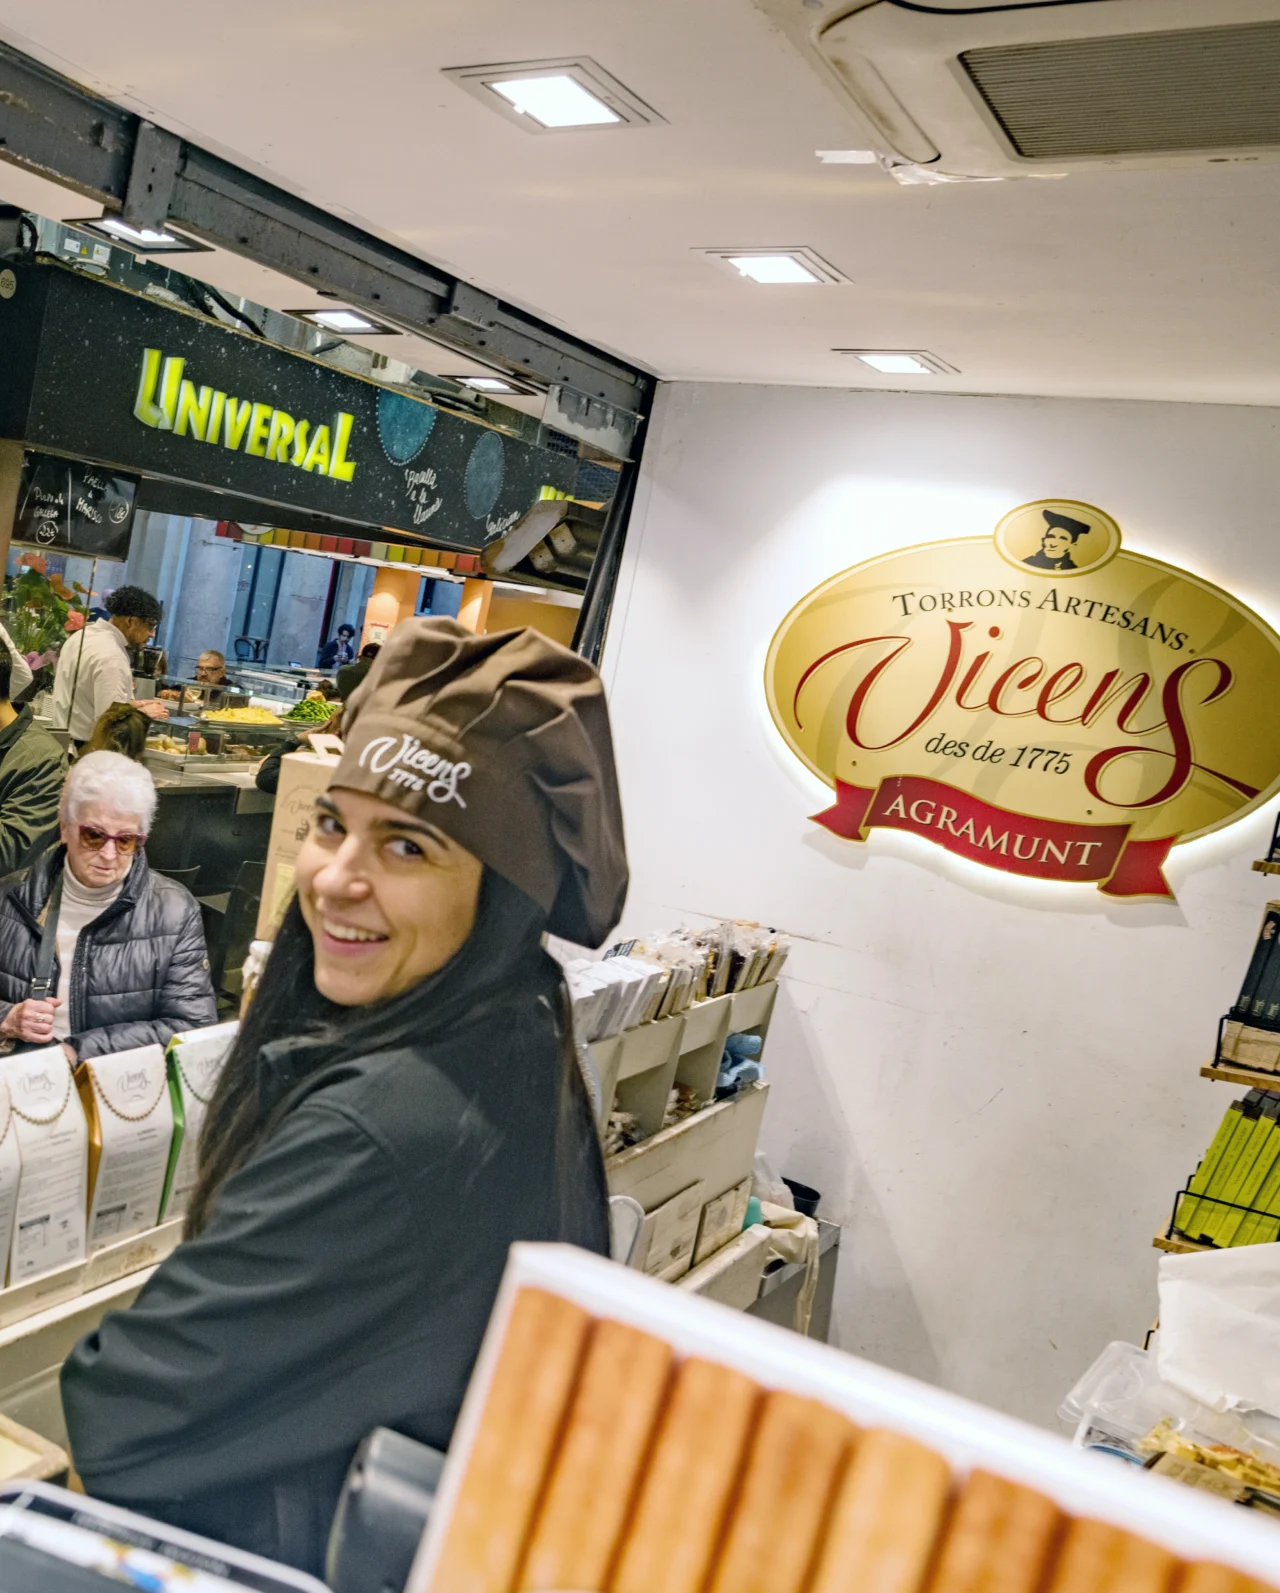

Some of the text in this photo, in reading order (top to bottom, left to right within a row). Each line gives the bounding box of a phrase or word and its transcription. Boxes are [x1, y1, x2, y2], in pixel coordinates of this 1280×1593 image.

[133, 348, 357, 482] UNIVERSAL
[892, 587, 1190, 652] TORRONS ARTESANS
[793, 618, 1263, 809] Vicens
[358, 733, 472, 809] Vicens
[1012, 746, 1074, 775] 1775
[883, 792, 1102, 867] AGRAMUNT
